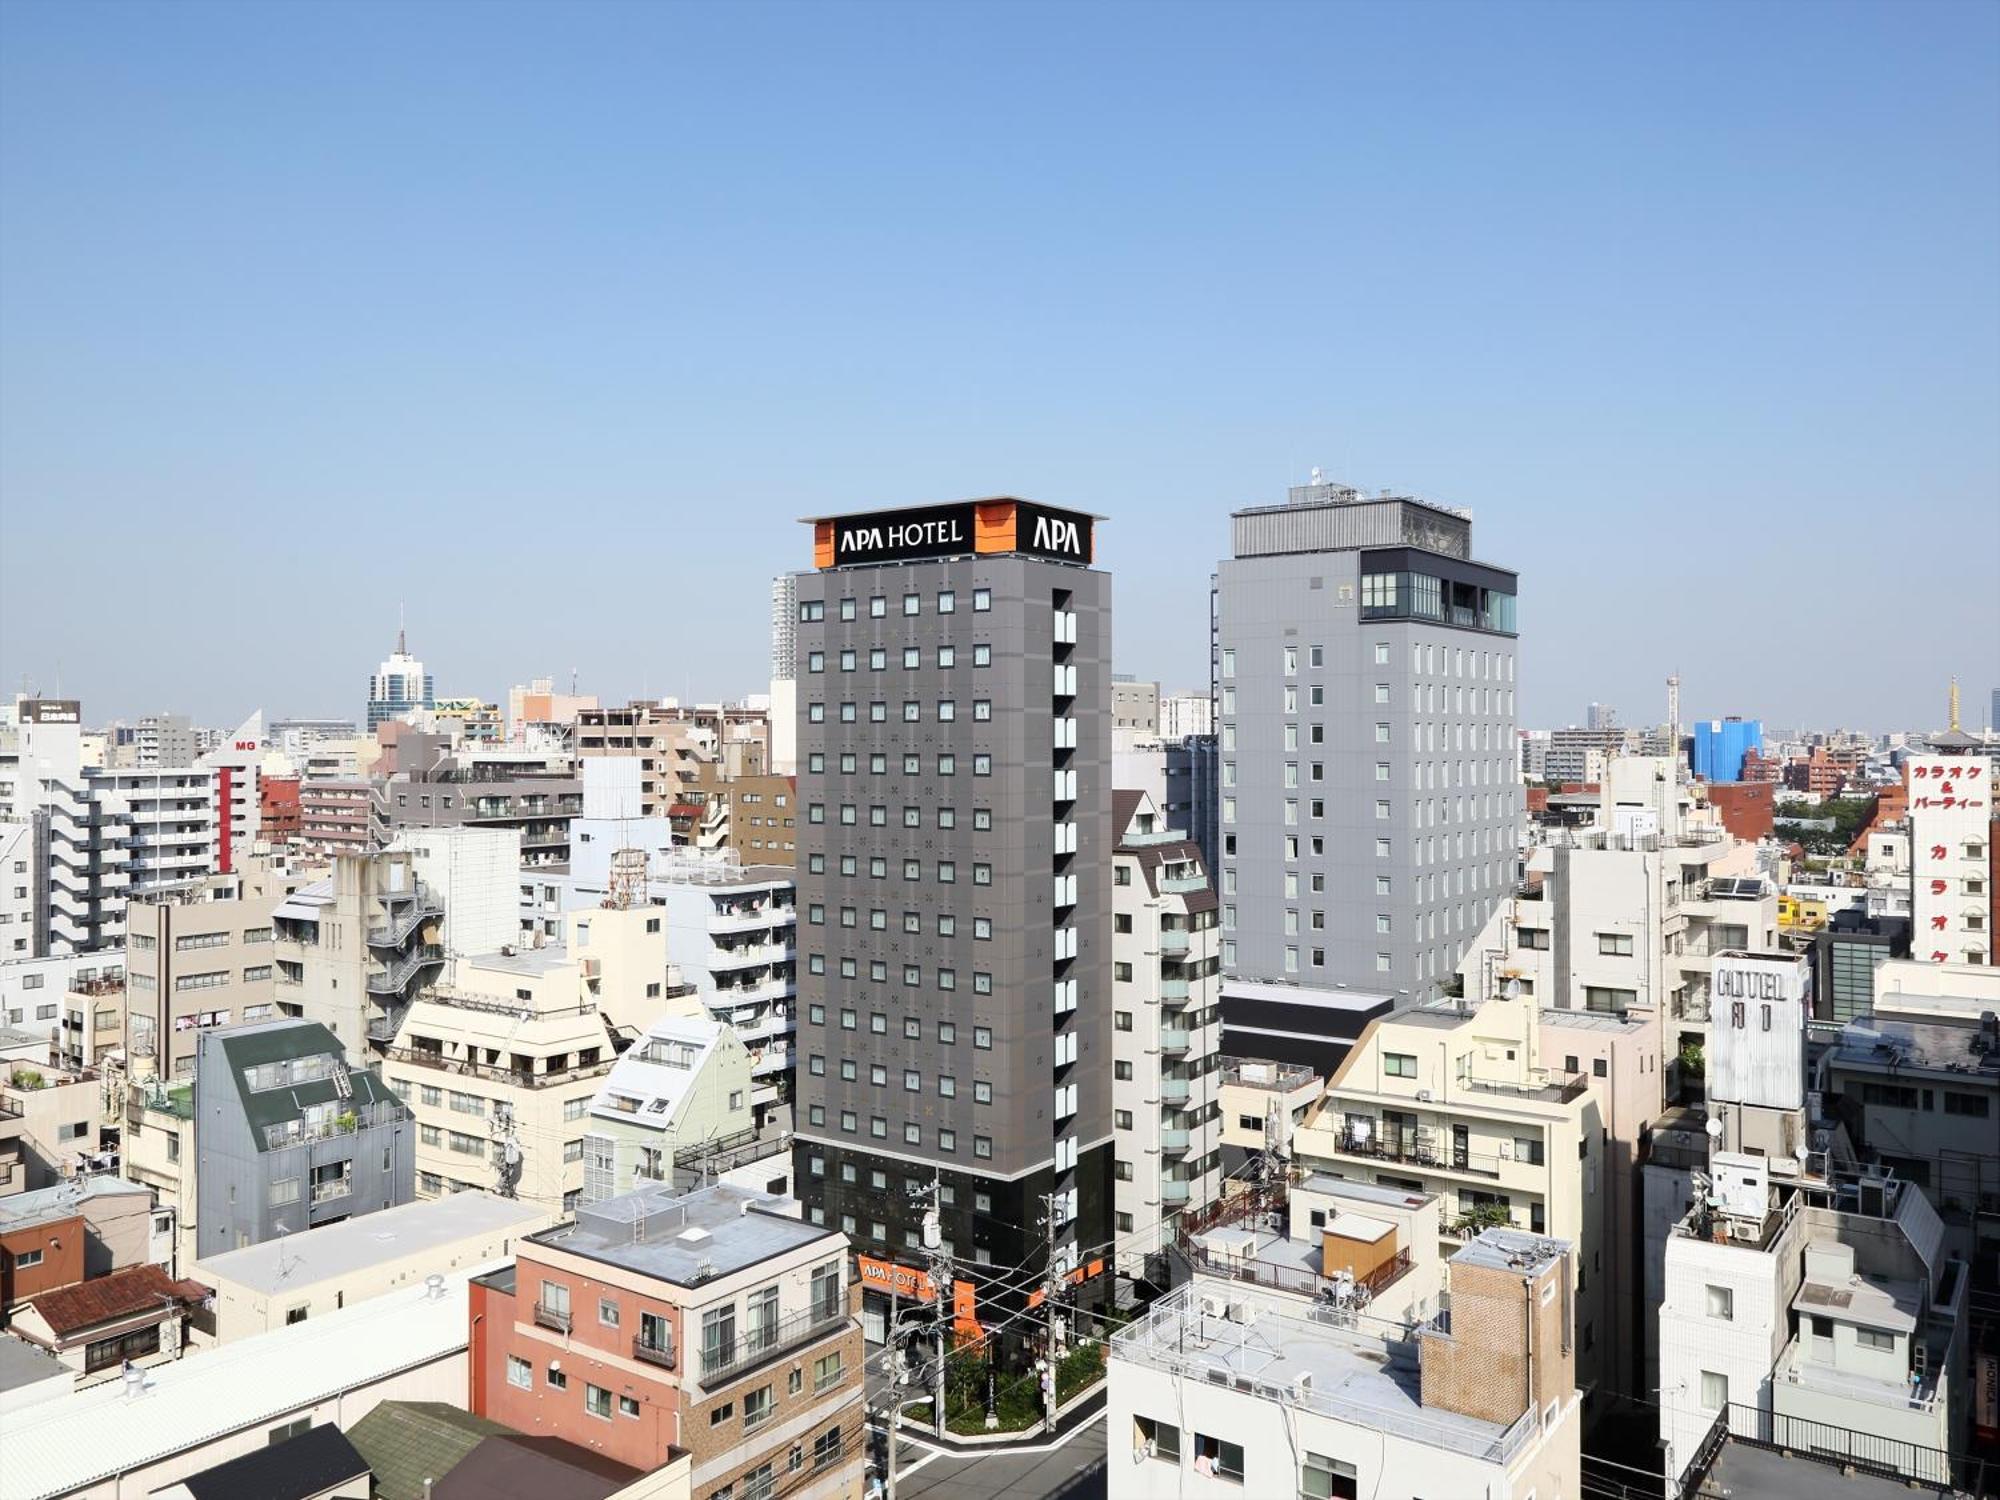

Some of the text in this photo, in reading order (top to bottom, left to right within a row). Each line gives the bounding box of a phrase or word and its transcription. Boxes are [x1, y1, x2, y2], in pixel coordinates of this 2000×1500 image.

[841, 520, 963, 552] APA HOTEL
[1033, 516, 1081, 554] APA
[236, 741, 255, 751] MG
[1913, 766, 1982, 779] カラオケ
[1941, 781, 1953, 793] &
[1718, 969, 1787, 1001] HOTEL
[864, 1264, 886, 1280] APA
